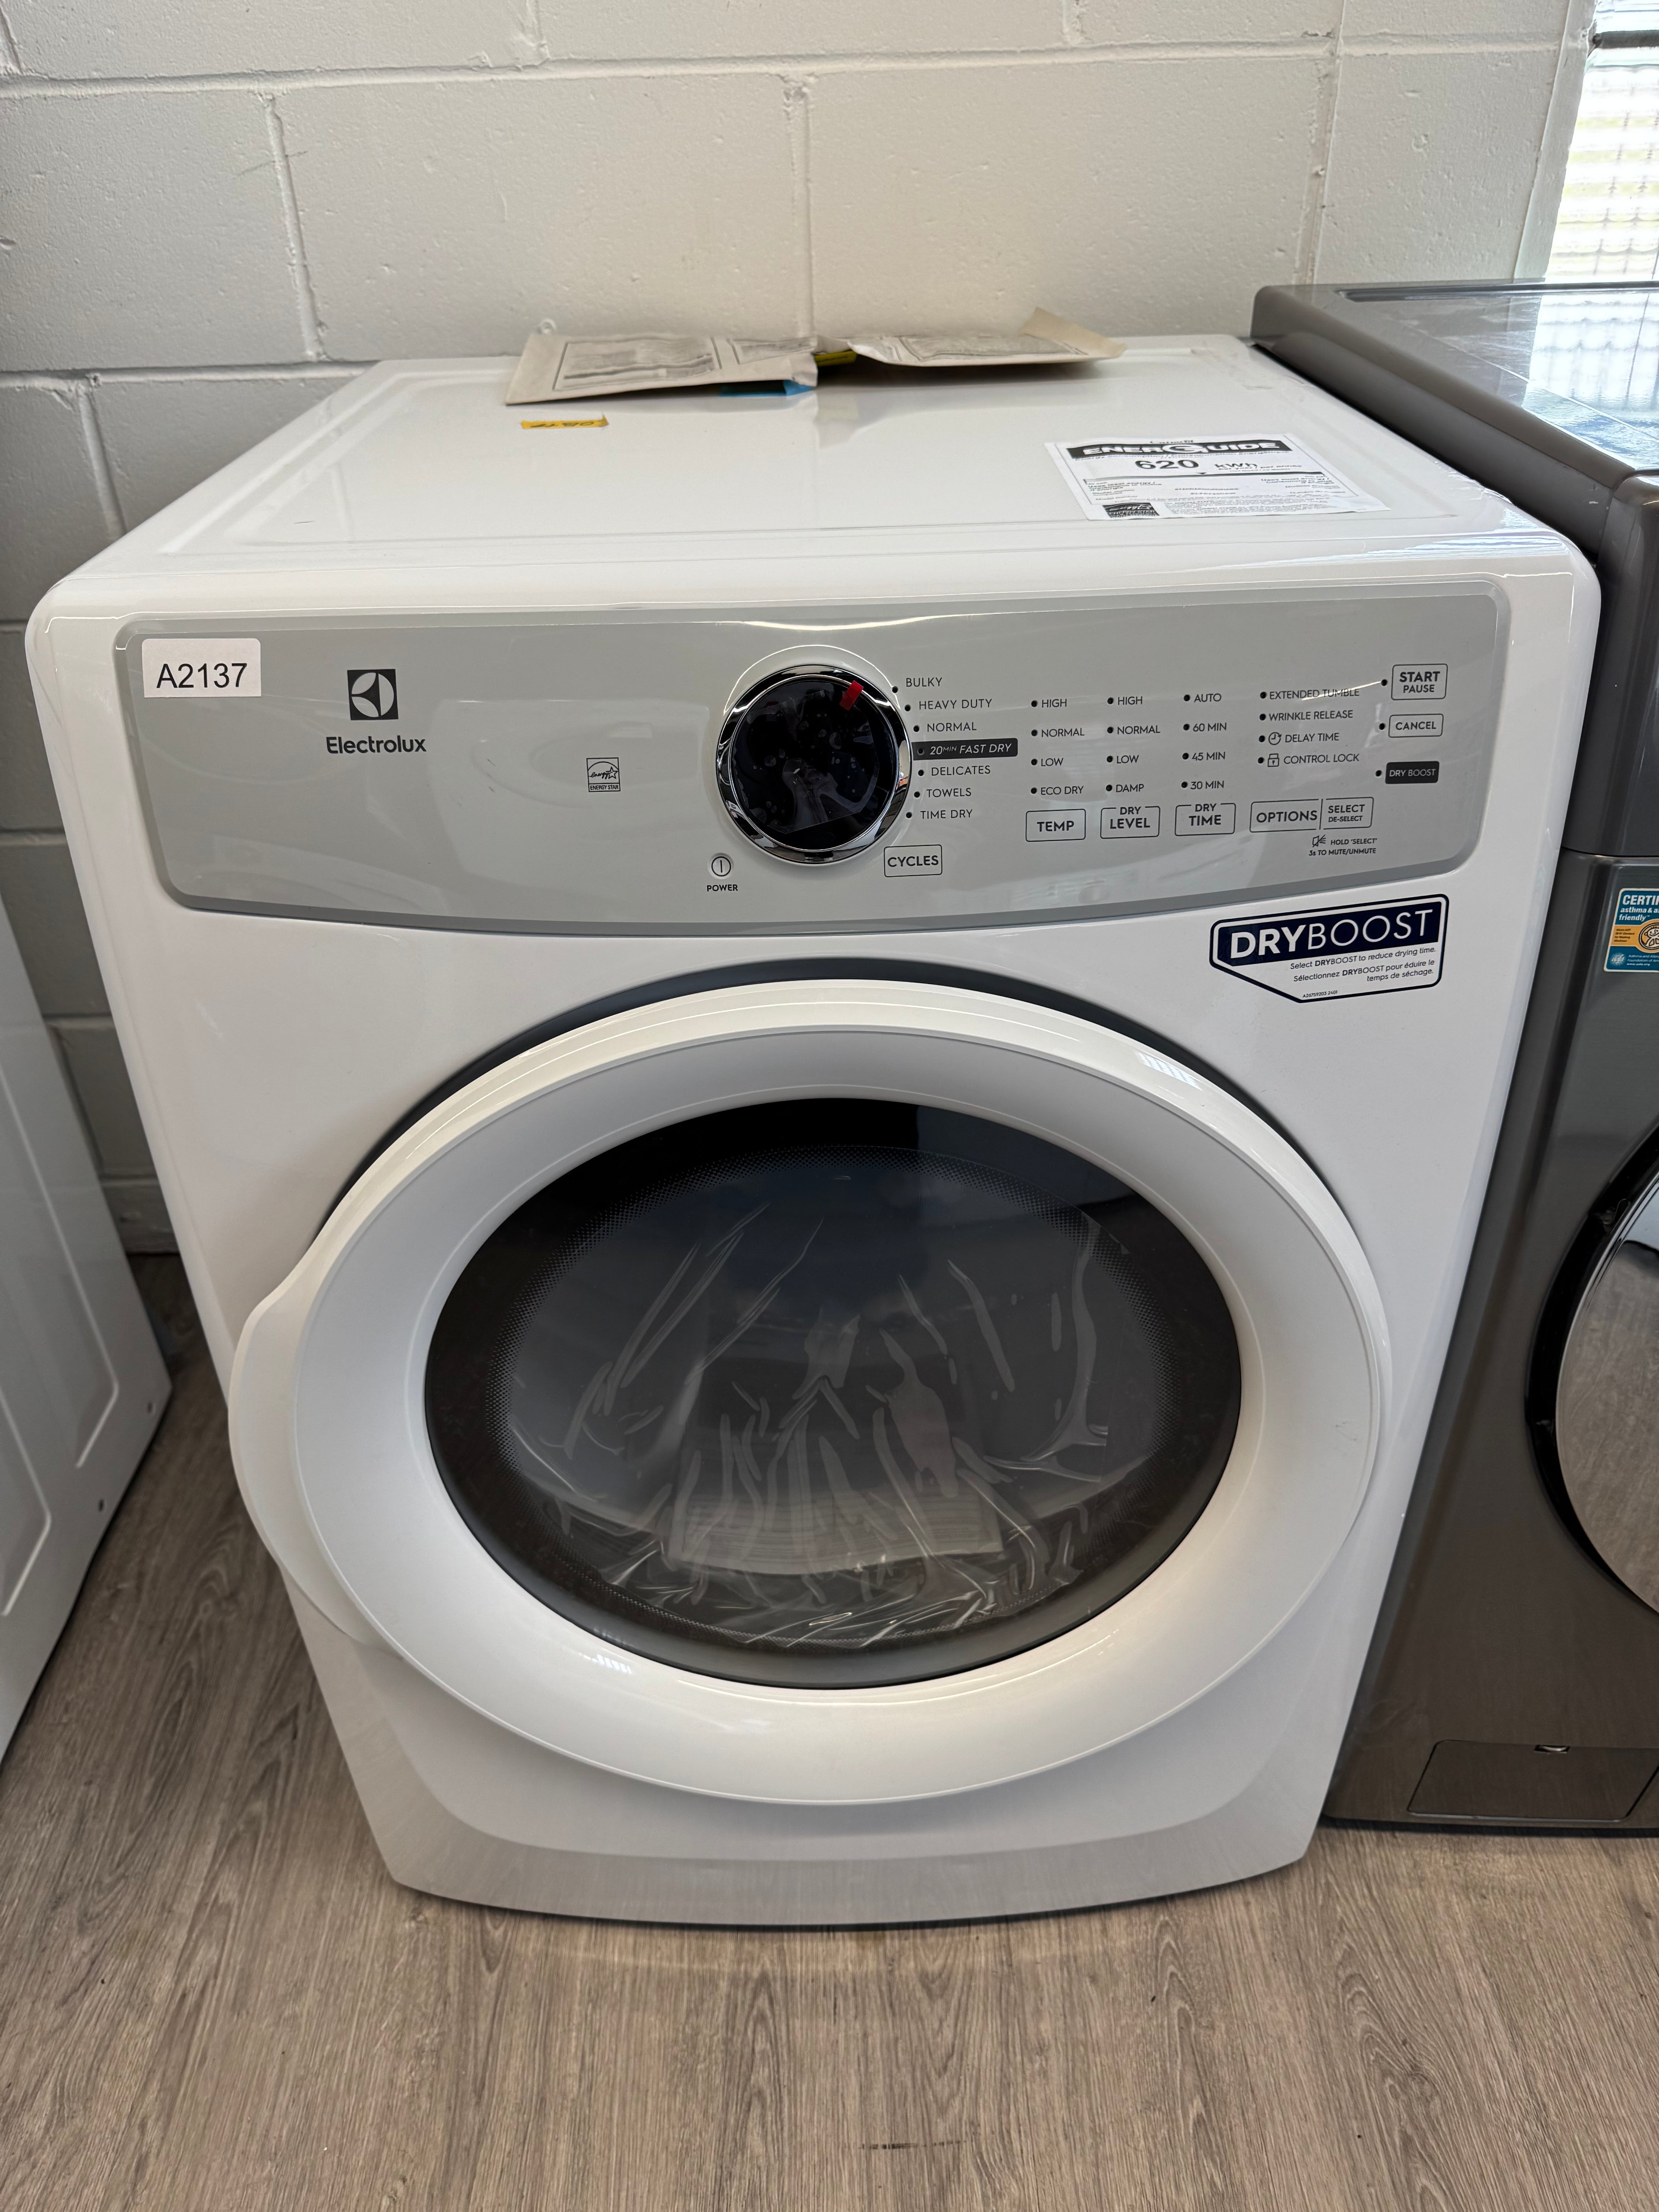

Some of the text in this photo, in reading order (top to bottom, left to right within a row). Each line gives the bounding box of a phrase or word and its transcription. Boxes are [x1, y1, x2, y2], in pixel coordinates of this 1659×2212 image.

[1135, 459, 1199, 470] 620
[156, 663, 247, 688] A2137
[1399, 671, 1440, 682] START
[906, 677, 942, 687] BULKY
[1403, 684, 1434, 693] PAUSE
[1194, 693, 1221, 702] AUTO
[1270, 689, 1360, 699] EXTENDED TUMBLE
[919, 699, 992, 710] HEAVY DUTY
[1042, 699, 1067, 708] HIGH
[1118, 696, 1142, 705] HIGH
[1269, 710, 1353, 721] WRINKLE RELEASE
[928, 722, 976, 732] NORMAL
[1118, 725, 1160, 734] NORMAL
[1193, 722, 1227, 732] 60 MIN
[1396, 721, 1436, 730] CANCEL
[1042, 728, 1084, 737] NORMAL
[1285, 733, 1339, 743] DELAY TIME
[326, 735, 426, 753] Electrolux
[960, 744, 986, 753] FAST
[989, 744, 1011, 752] DRY
[1117, 755, 1139, 763] LOW
[1192, 752, 1225, 761] 45 MIN
[1284, 754, 1359, 764] CONTROL LOCK
[1041, 758, 1063, 766] LOW
[932, 766, 990, 775] DELICATES
[1116, 784, 1144, 792] DAMP
[1191, 781, 1224, 789] 30 MIN
[926, 788, 971, 798] TOWELS
[1041, 786, 1084, 795] ECO DRY
[1120, 807, 1141, 815] DRY
[1195, 803, 1217, 812] DRY
[1328, 804, 1365, 813] SELECT
[920, 809, 973, 819] TIME DRY
[1256, 810, 1317, 823] OPTIONS
[1110, 818, 1150, 829] LEVEL
[1189, 815, 1221, 826] TIME
[1037, 821, 1074, 832] TEMP
[888, 855, 938, 867] CYCLES
[1230, 909, 1433, 959] DRYBOOST
[1290, 961, 1313, 969] Select
[1315, 956, 1357, 966] DRYBOOST
[1395, 949, 1417, 957] drying
[1294, 972, 1340, 982] Sélectionnez
[1342, 966, 1384, 976] DRYBOOST
[1402, 968, 1433, 978] séchage.
